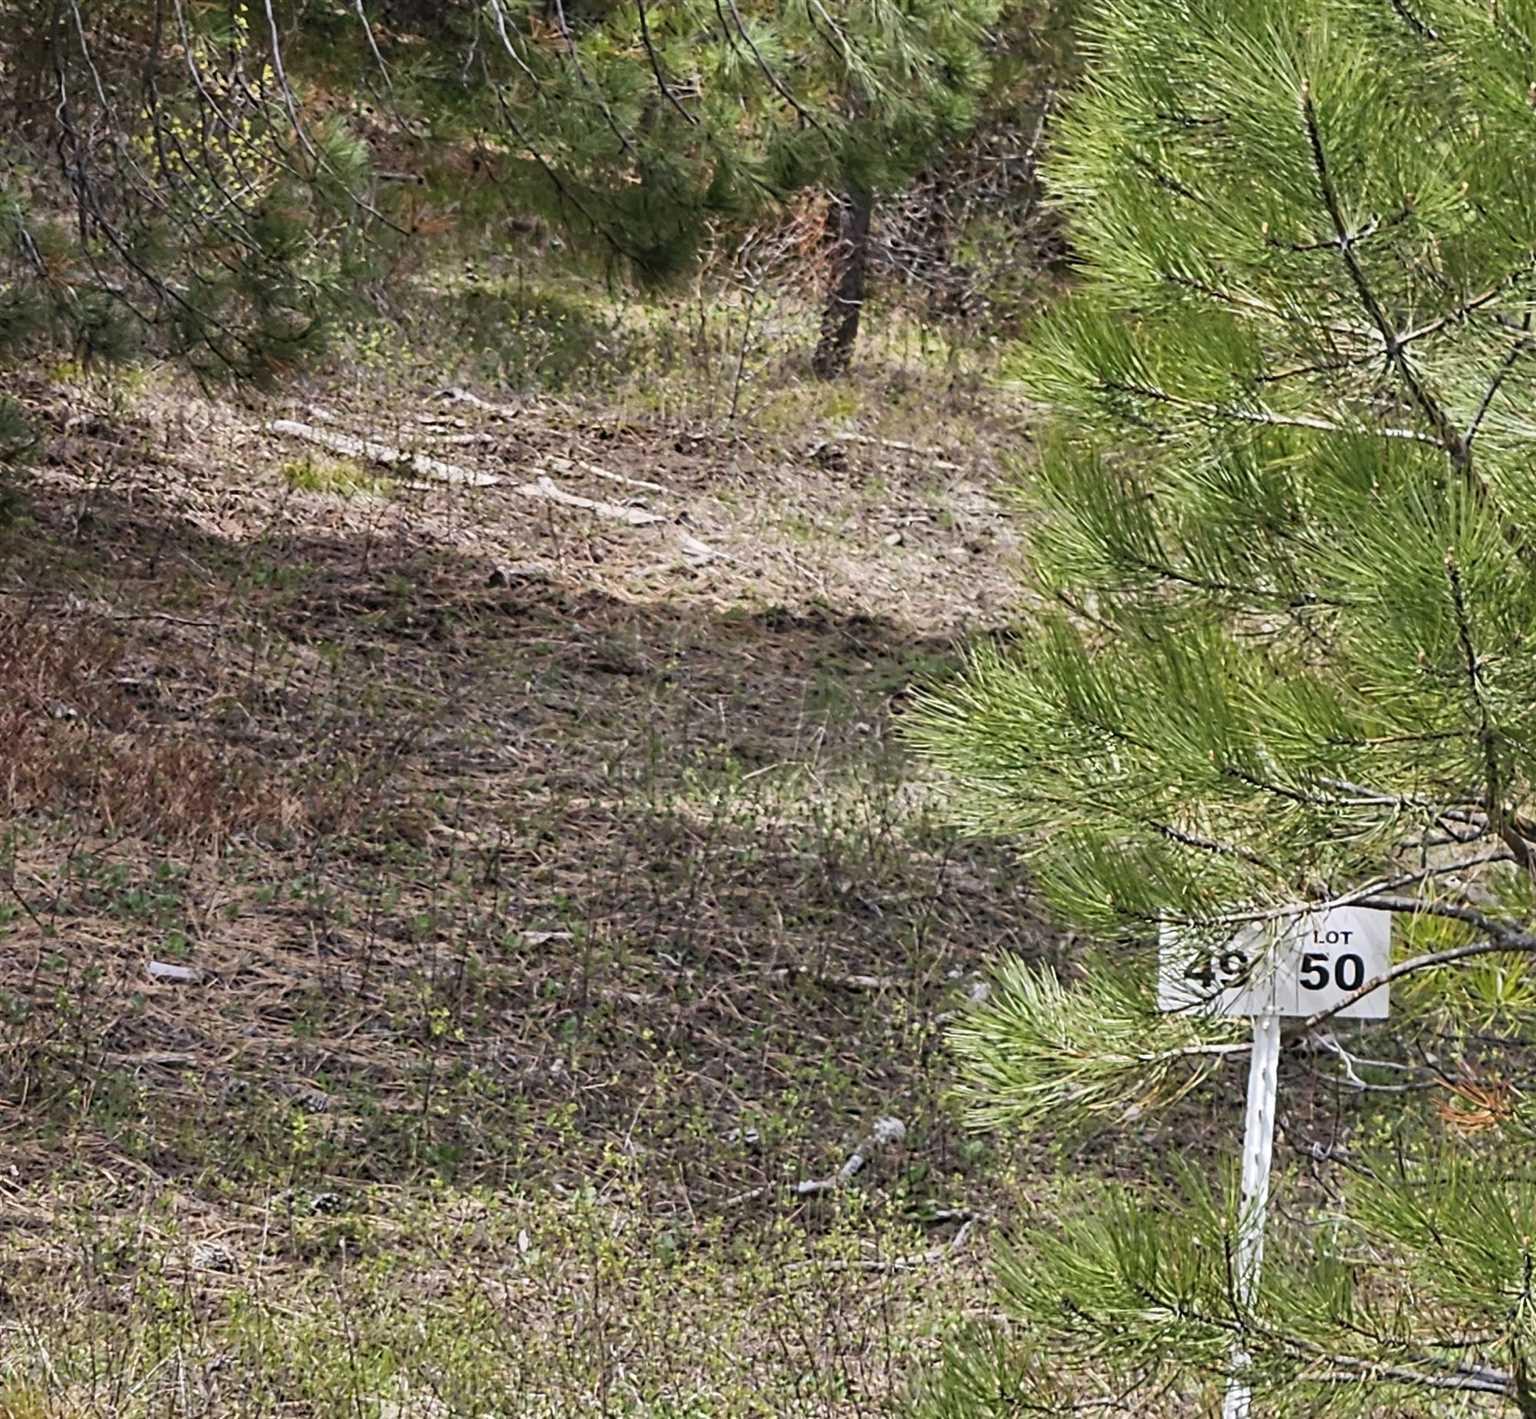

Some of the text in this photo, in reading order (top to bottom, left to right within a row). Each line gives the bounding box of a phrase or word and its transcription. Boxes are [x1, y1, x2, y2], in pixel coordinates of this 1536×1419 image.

[1313, 930, 1353, 945] LOT
[1184, 950, 1249, 988] 49
[1299, 953, 1365, 991] 50
